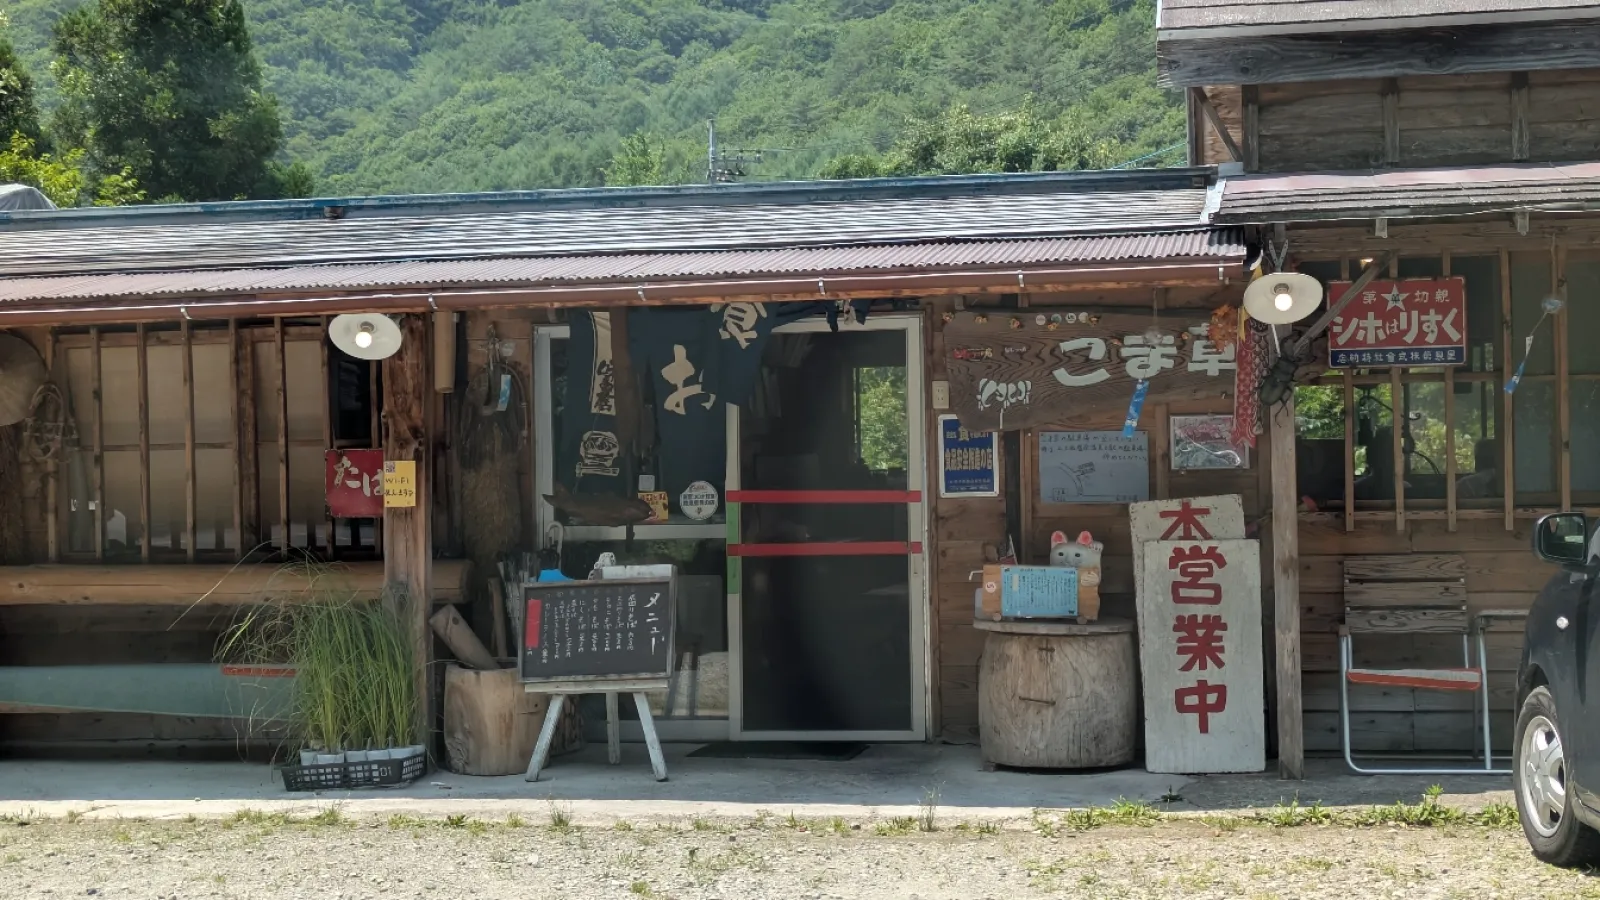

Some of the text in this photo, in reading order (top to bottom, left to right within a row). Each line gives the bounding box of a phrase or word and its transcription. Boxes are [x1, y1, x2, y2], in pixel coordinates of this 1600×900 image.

[643, 592, 662, 656] メニュー
[1168, 544, 1228, 734] 営業中
